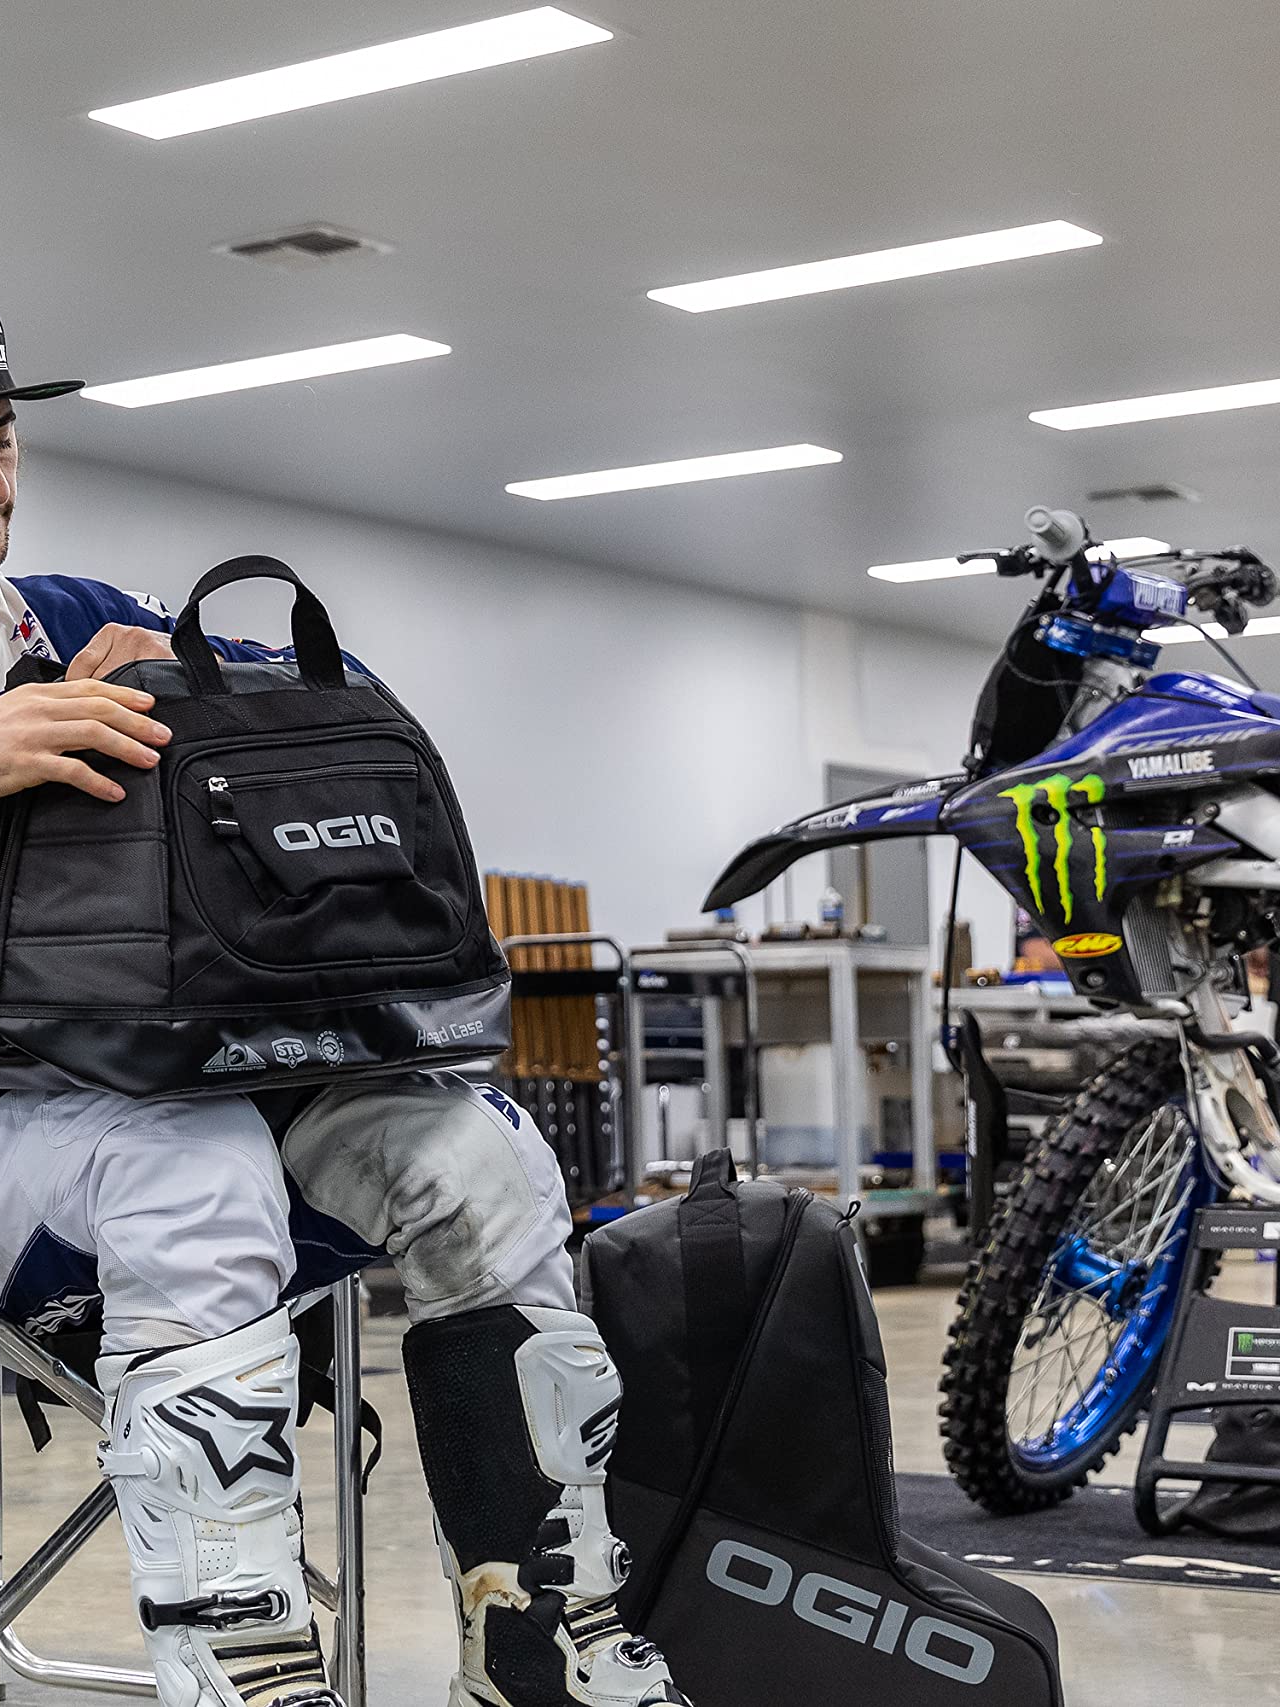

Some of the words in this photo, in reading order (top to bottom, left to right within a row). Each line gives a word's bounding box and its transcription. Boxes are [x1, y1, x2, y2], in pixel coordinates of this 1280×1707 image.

[1127, 750, 1215, 779] YAMALUBE
[272, 814, 402, 852] OGIO
[415, 1026, 450, 1047] Head
[449, 1020, 484, 1040] Case
[275, 1043, 304, 1056] STS
[705, 1538, 996, 1686] OGIO
